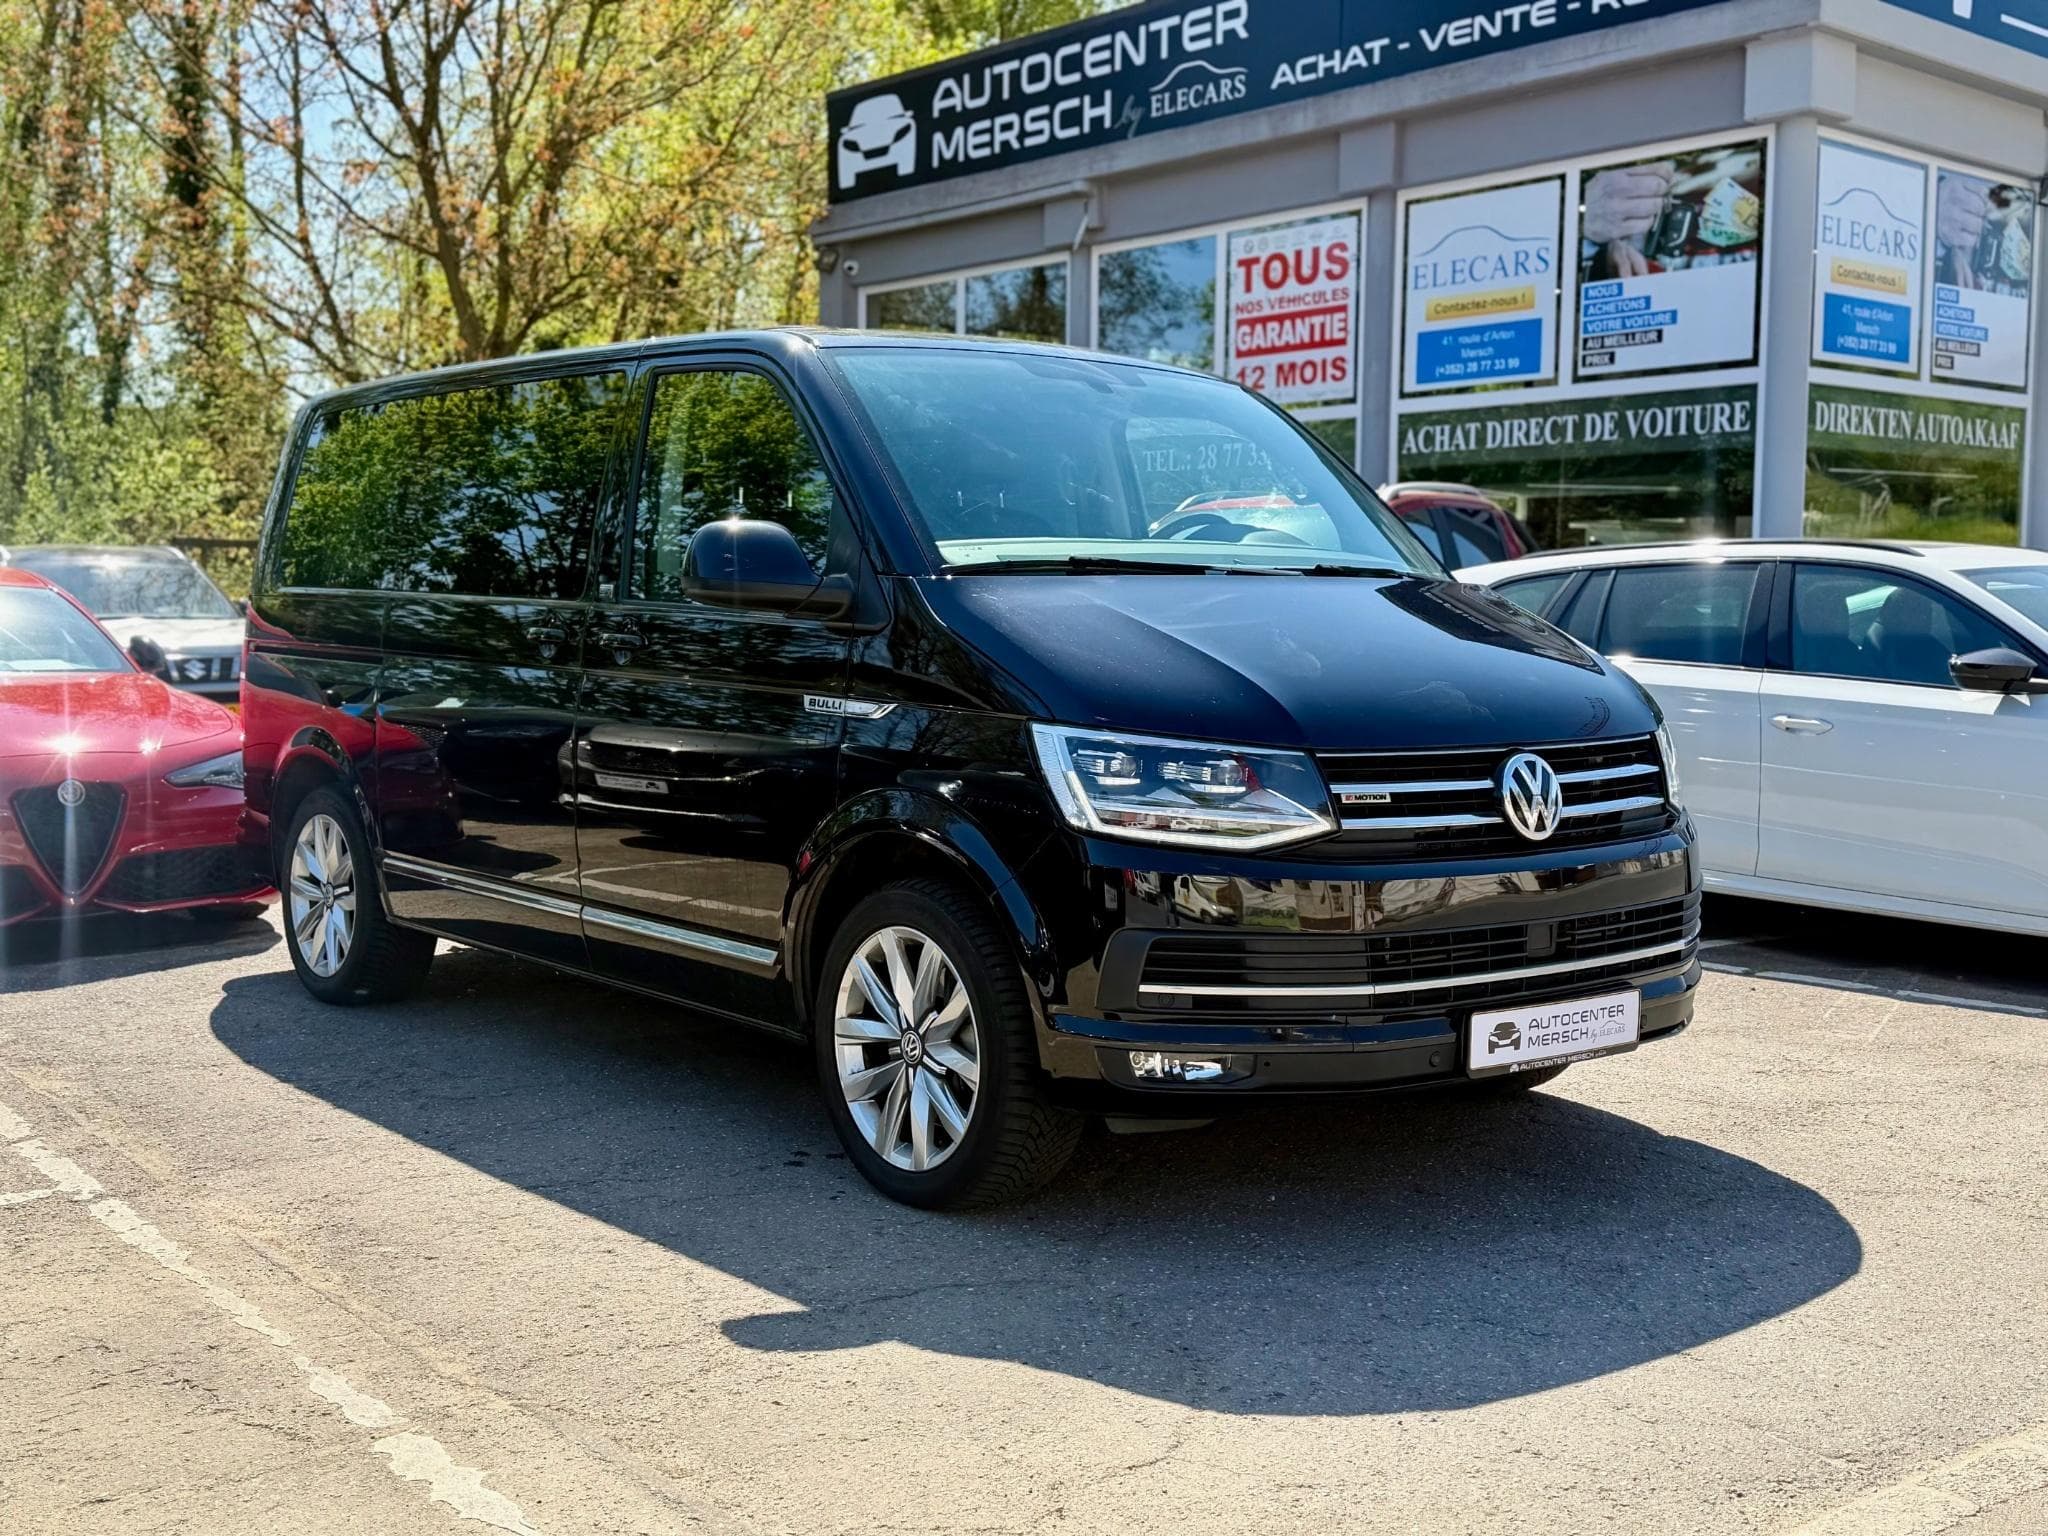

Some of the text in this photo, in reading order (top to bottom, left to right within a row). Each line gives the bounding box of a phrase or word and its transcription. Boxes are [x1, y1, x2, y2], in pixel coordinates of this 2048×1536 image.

[932, 0, 1249, 118] AUTOCENTER
[1270, 38, 1390, 90] ACHAT
[1419, 0, 1557, 52] VENTE
[931, 74, 1247, 168] MERSCH by ELECARS
[1822, 214, 1918, 261] ELECARS
[1237, 242, 1349, 294] TOUS
[1413, 247, 1550, 290] ELECARS
[1433, 296, 1518, 315] Contactez-nous
[1587, 285, 1618, 298] NOUS
[1235, 299, 1263, 315] NOS
[1587, 298, 1646, 315] ACHETONS
[1237, 312, 1346, 352] GARANTIE
[1586, 312, 1672, 333] VOTRE VOITURE
[1585, 331, 1658, 349] AU MEILLEUR
[1236, 356, 1347, 389] 12 MOIS
[1585, 354, 1611, 366] PRIX
[1402, 401, 1751, 454] ACHAT DIRECT DE VOITURE
[1815, 401, 2020, 449] DIREKTEN AUTOAKAAF
[1142, 449, 1191, 472] TEL.:
[1199, 446, 1216, 470] 28
[1223, 443, 1242, 466] 77
[809, 698, 842, 710] BULLI
[1528, 1004, 1625, 1031] AUTOCENTER
[1528, 1027, 1589, 1048] MERSCH
[1520, 1056, 1567, 1071] AUTOCENTER
[1568, 1052, 1594, 1062] MERSCH
